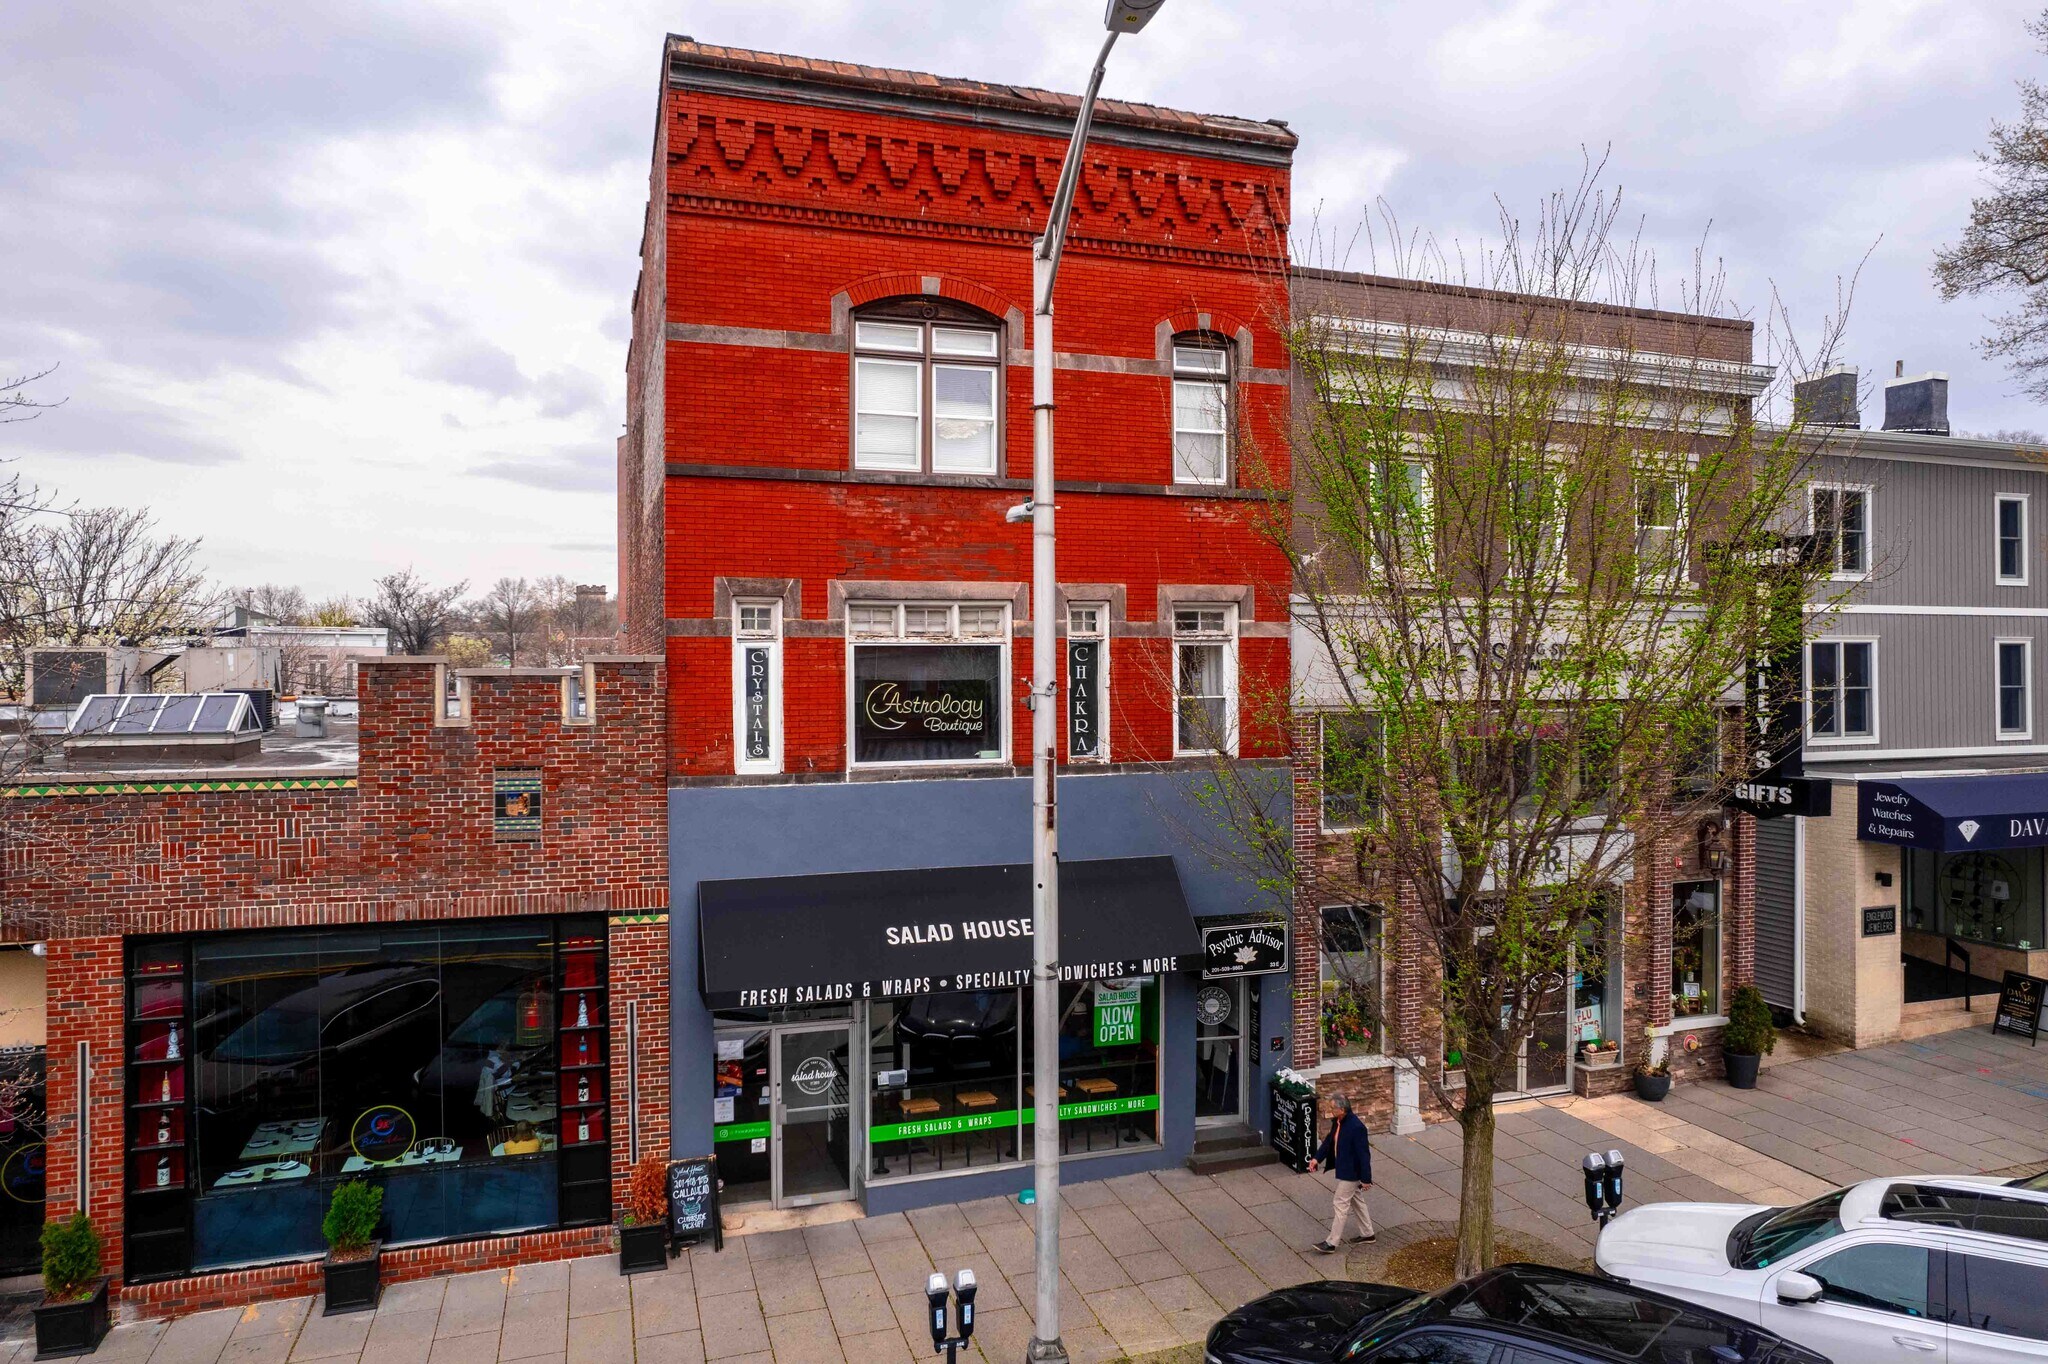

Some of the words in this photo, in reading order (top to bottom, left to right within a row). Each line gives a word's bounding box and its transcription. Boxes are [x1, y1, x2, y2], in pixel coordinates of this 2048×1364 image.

[751, 651, 764, 756] CRYSTALS
[871, 692, 983, 719] Astrology
[1074, 647, 1089, 751] CHAKRA
[923, 717, 983, 734] Boutique
[1734, 783, 1793, 806] GIFTS
[1874, 792, 1910, 807] Jewelry
[1872, 807, 1912, 822] Watches
[1868, 823, 1876, 835] &
[1878, 824, 1915, 839] Repairs
[2009, 818, 2048, 838] DAV
[1865, 910, 1893, 923] ENGLEWOOD
[886, 923, 954, 945] SALAD
[962, 918, 1034, 940] HOUSE
[1866, 921, 1894, 934] JEWELERS
[1208, 930, 1244, 957] Psychic
[1248, 928, 1284, 951] Advisor
[740, 987, 788, 1007] FRESH
[796, 982, 853, 1003] SALADS
[863, 981, 870, 997] &
[882, 976, 931, 996] WRAPS
[956, 968, 1031, 990] SPECIALTY
[1057, 960, 1123, 982] NDWICHES
[1142, 956, 1178, 974] MORE
[1098, 992, 1118, 1002] SALAD
[1118, 990, 1138, 1001] HOUSE
[1101, 1005, 1135, 1026] NOW
[1100, 1024, 1134, 1042] OPEN
[790, 1069, 815, 1082] salad
[815, 1069, 838, 1080] house
[898, 1124, 922, 1136] FRESH
[924, 1120, 952, 1133] SALADS
[957, 1120, 962, 1129] &
[967, 1115, 993, 1128] WRAPS
[1073, 1101, 1118, 1115] SANDWICHES
[1127, 1099, 1146, 1109] MORE
[1304, 1106, 1312, 1163] PSYCHIC
